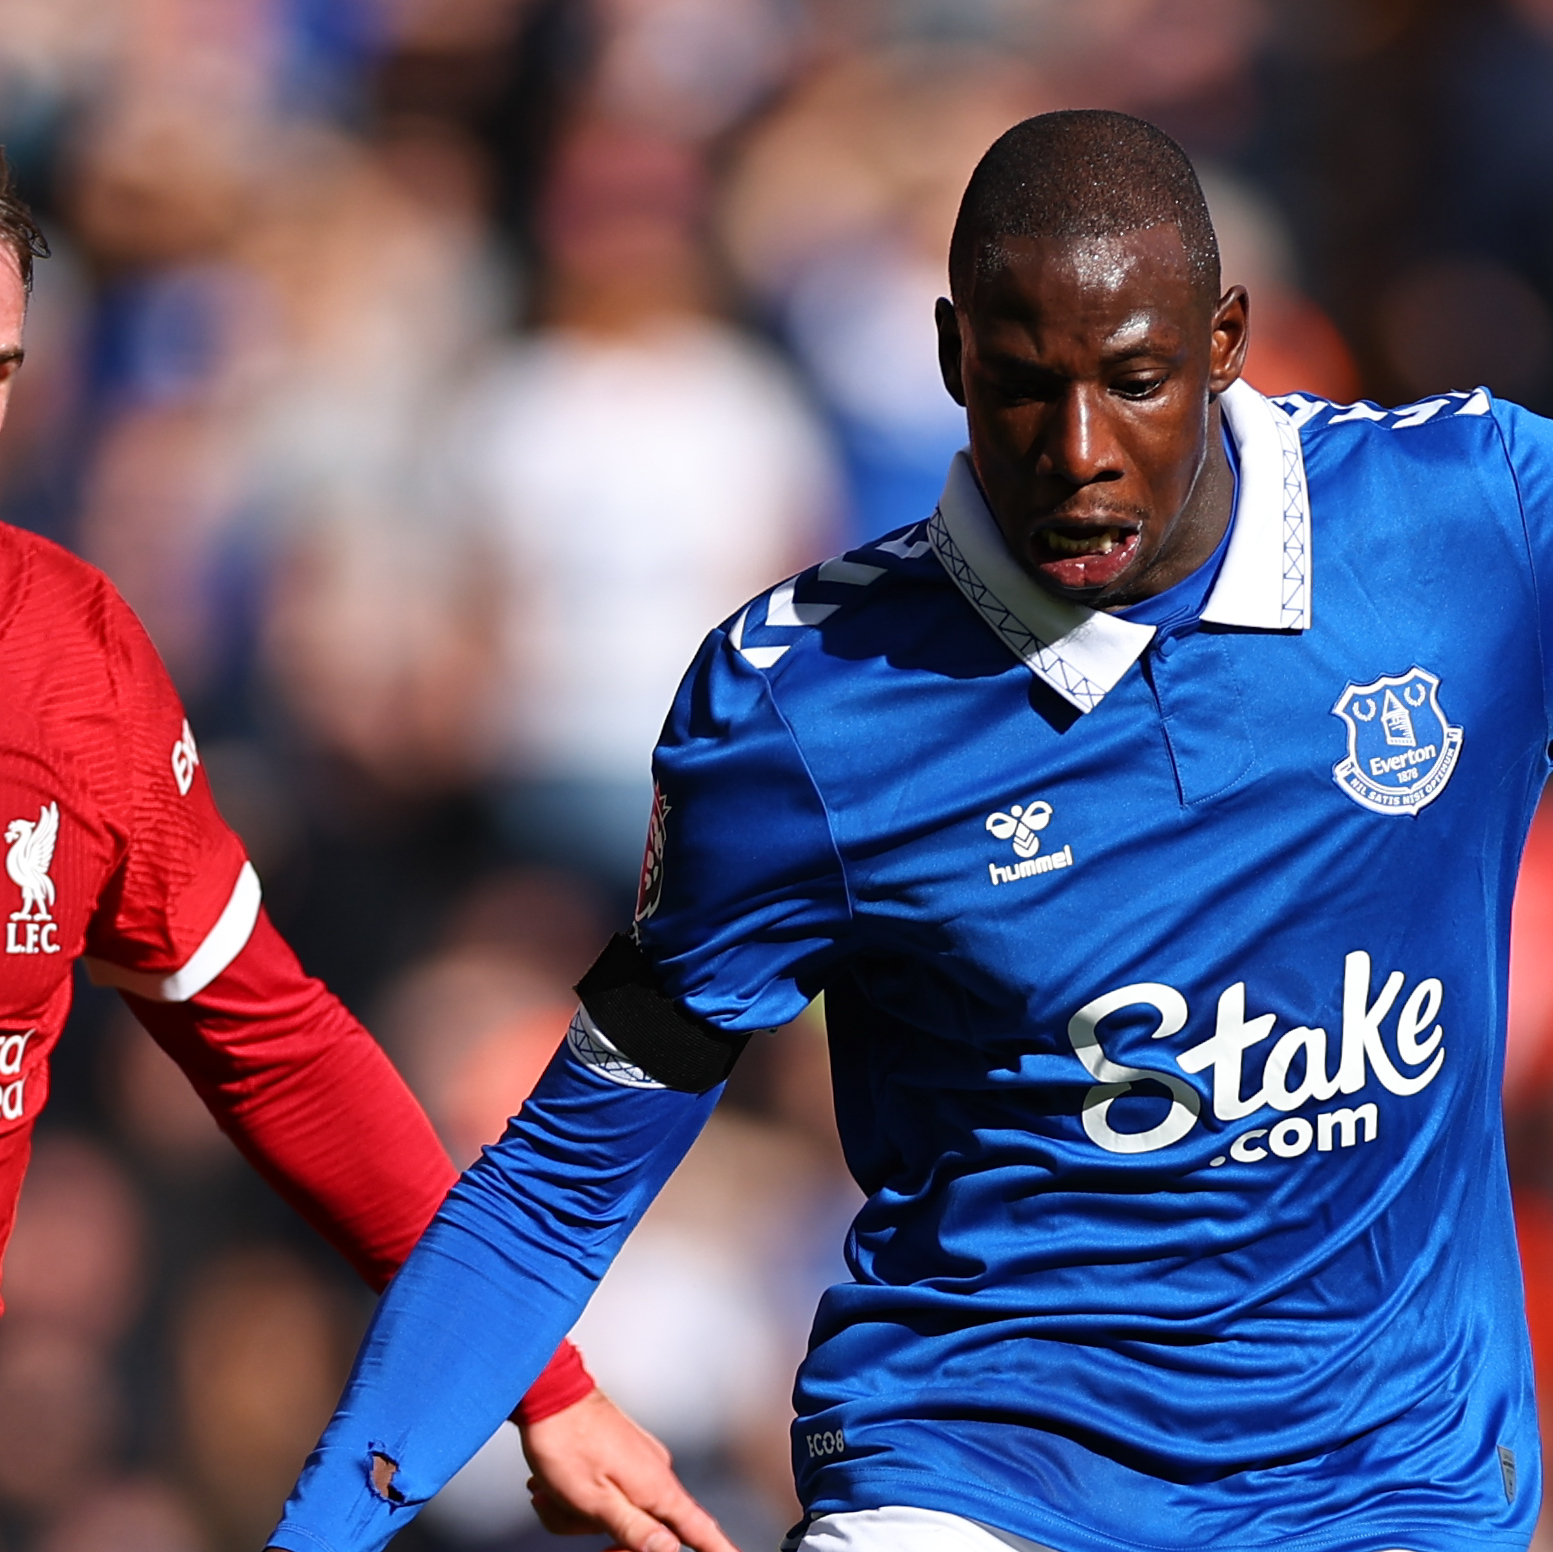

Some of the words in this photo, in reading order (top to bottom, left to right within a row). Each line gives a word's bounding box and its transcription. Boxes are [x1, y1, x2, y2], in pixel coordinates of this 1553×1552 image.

[1350, 777, 1367, 797] NIL
[1367, 790, 1401, 806] SATIS
[1402, 790, 1425, 806] NISI
[1425, 747, 1456, 793] OPTIMUM
[1369, 744, 1436, 775] Everton
[1397, 768, 1419, 784] 1878
[989, 845, 1073, 886] hummel
[1067, 949, 1447, 1155] Stake
[1208, 1100, 1379, 1168] .com
